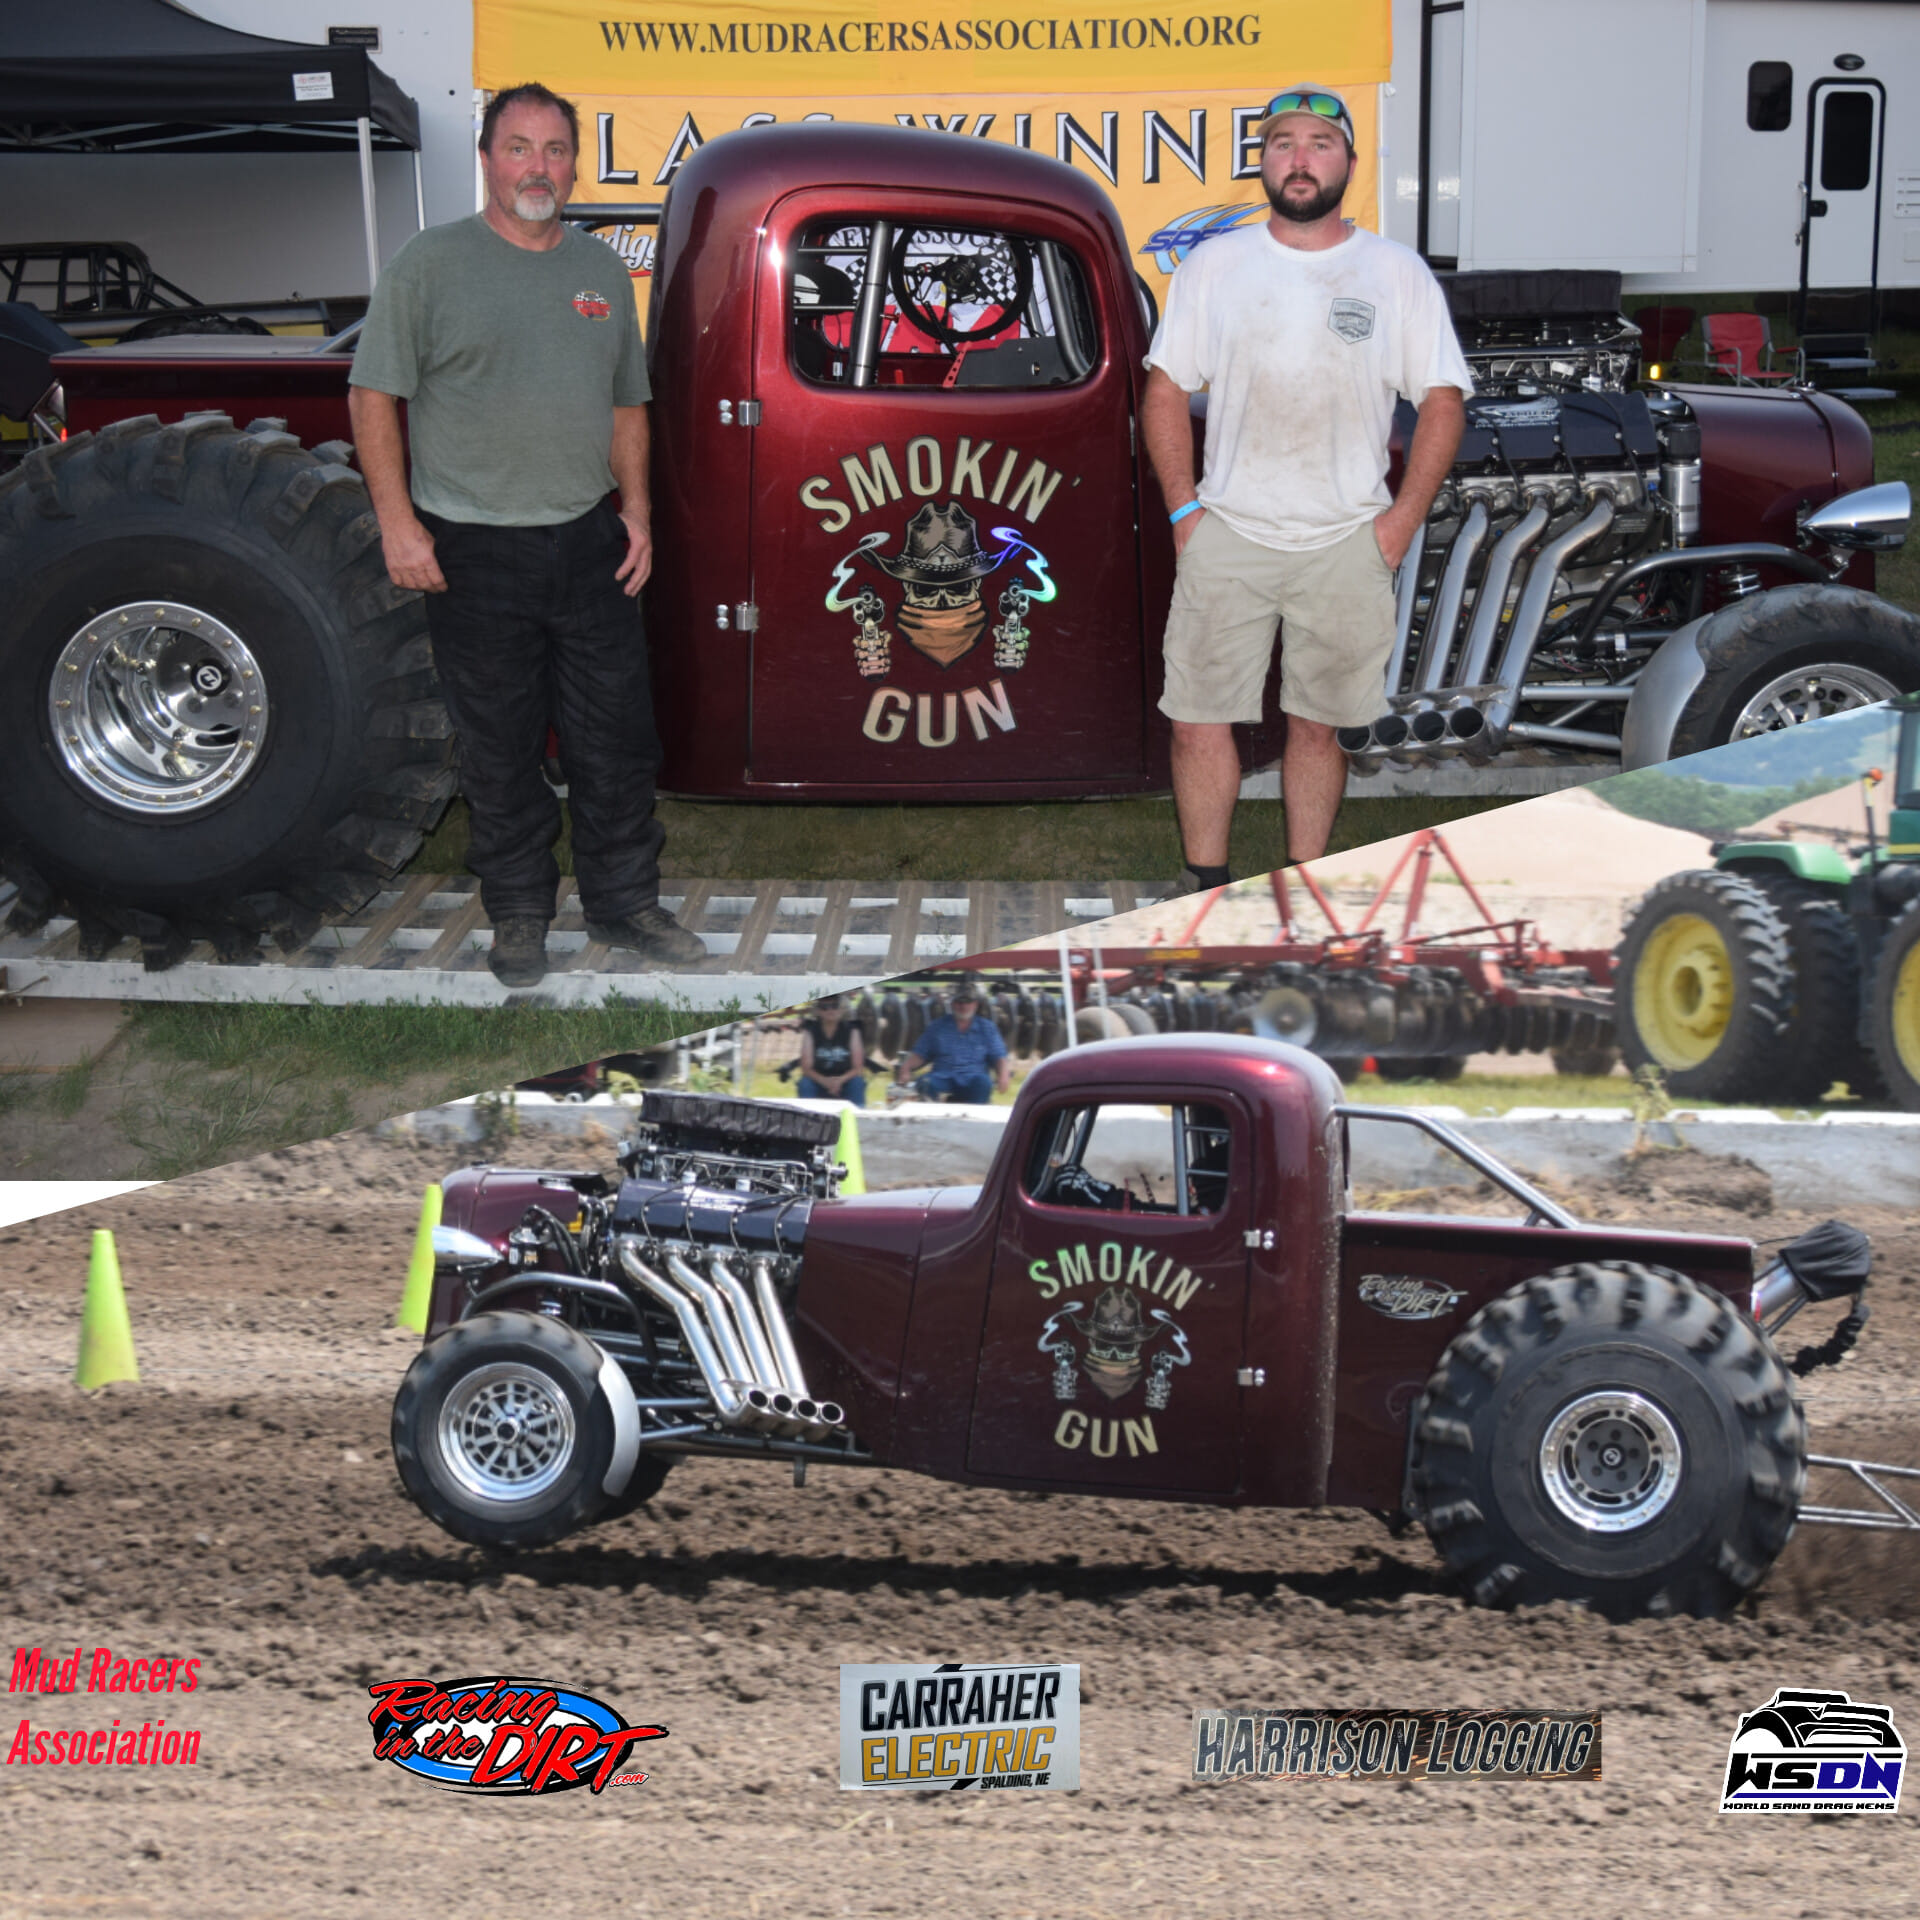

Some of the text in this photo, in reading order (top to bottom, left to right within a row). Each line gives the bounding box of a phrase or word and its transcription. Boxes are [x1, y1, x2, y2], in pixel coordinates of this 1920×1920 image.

[599, 14, 1262, 53] WWW.MUDRACERSASSOCIATION.ORG
[861, 678, 1018, 749] GUN
[1054, 1409, 1160, 1458] GUN
